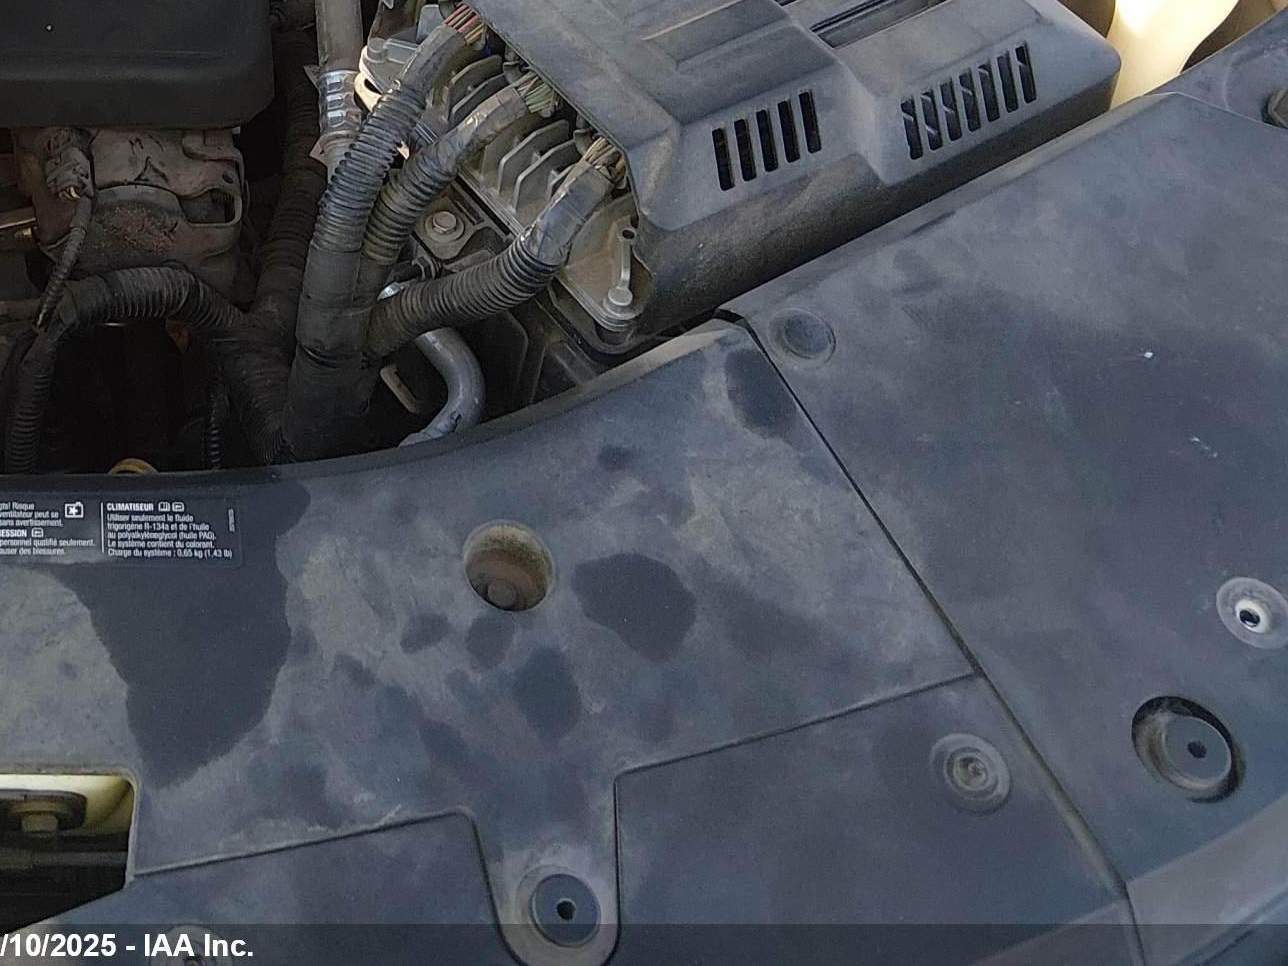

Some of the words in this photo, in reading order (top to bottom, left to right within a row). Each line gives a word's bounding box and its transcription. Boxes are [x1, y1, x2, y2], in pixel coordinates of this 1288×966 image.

[12, 502, 34, 510] Risque
[107, 503, 154, 511] CLIMATISEUR
[0, 510, 32, 518] ventilateur
[34, 510, 49, 518] peut
[51, 510, 58, 518] se
[144, 523, 169, 531] R-134a
[171, 523, 177, 531] et
[180, 523, 187, 531] de
[0, 538, 32, 546] personnel
[34, 538, 57, 546] qualifié
[59, 538, 95, 546] seulement.
[19, 547, 30, 555] des
[108, 550, 131, 558] Charge
[133, 550, 142, 558] du
[194, 550, 203, 558] kg
